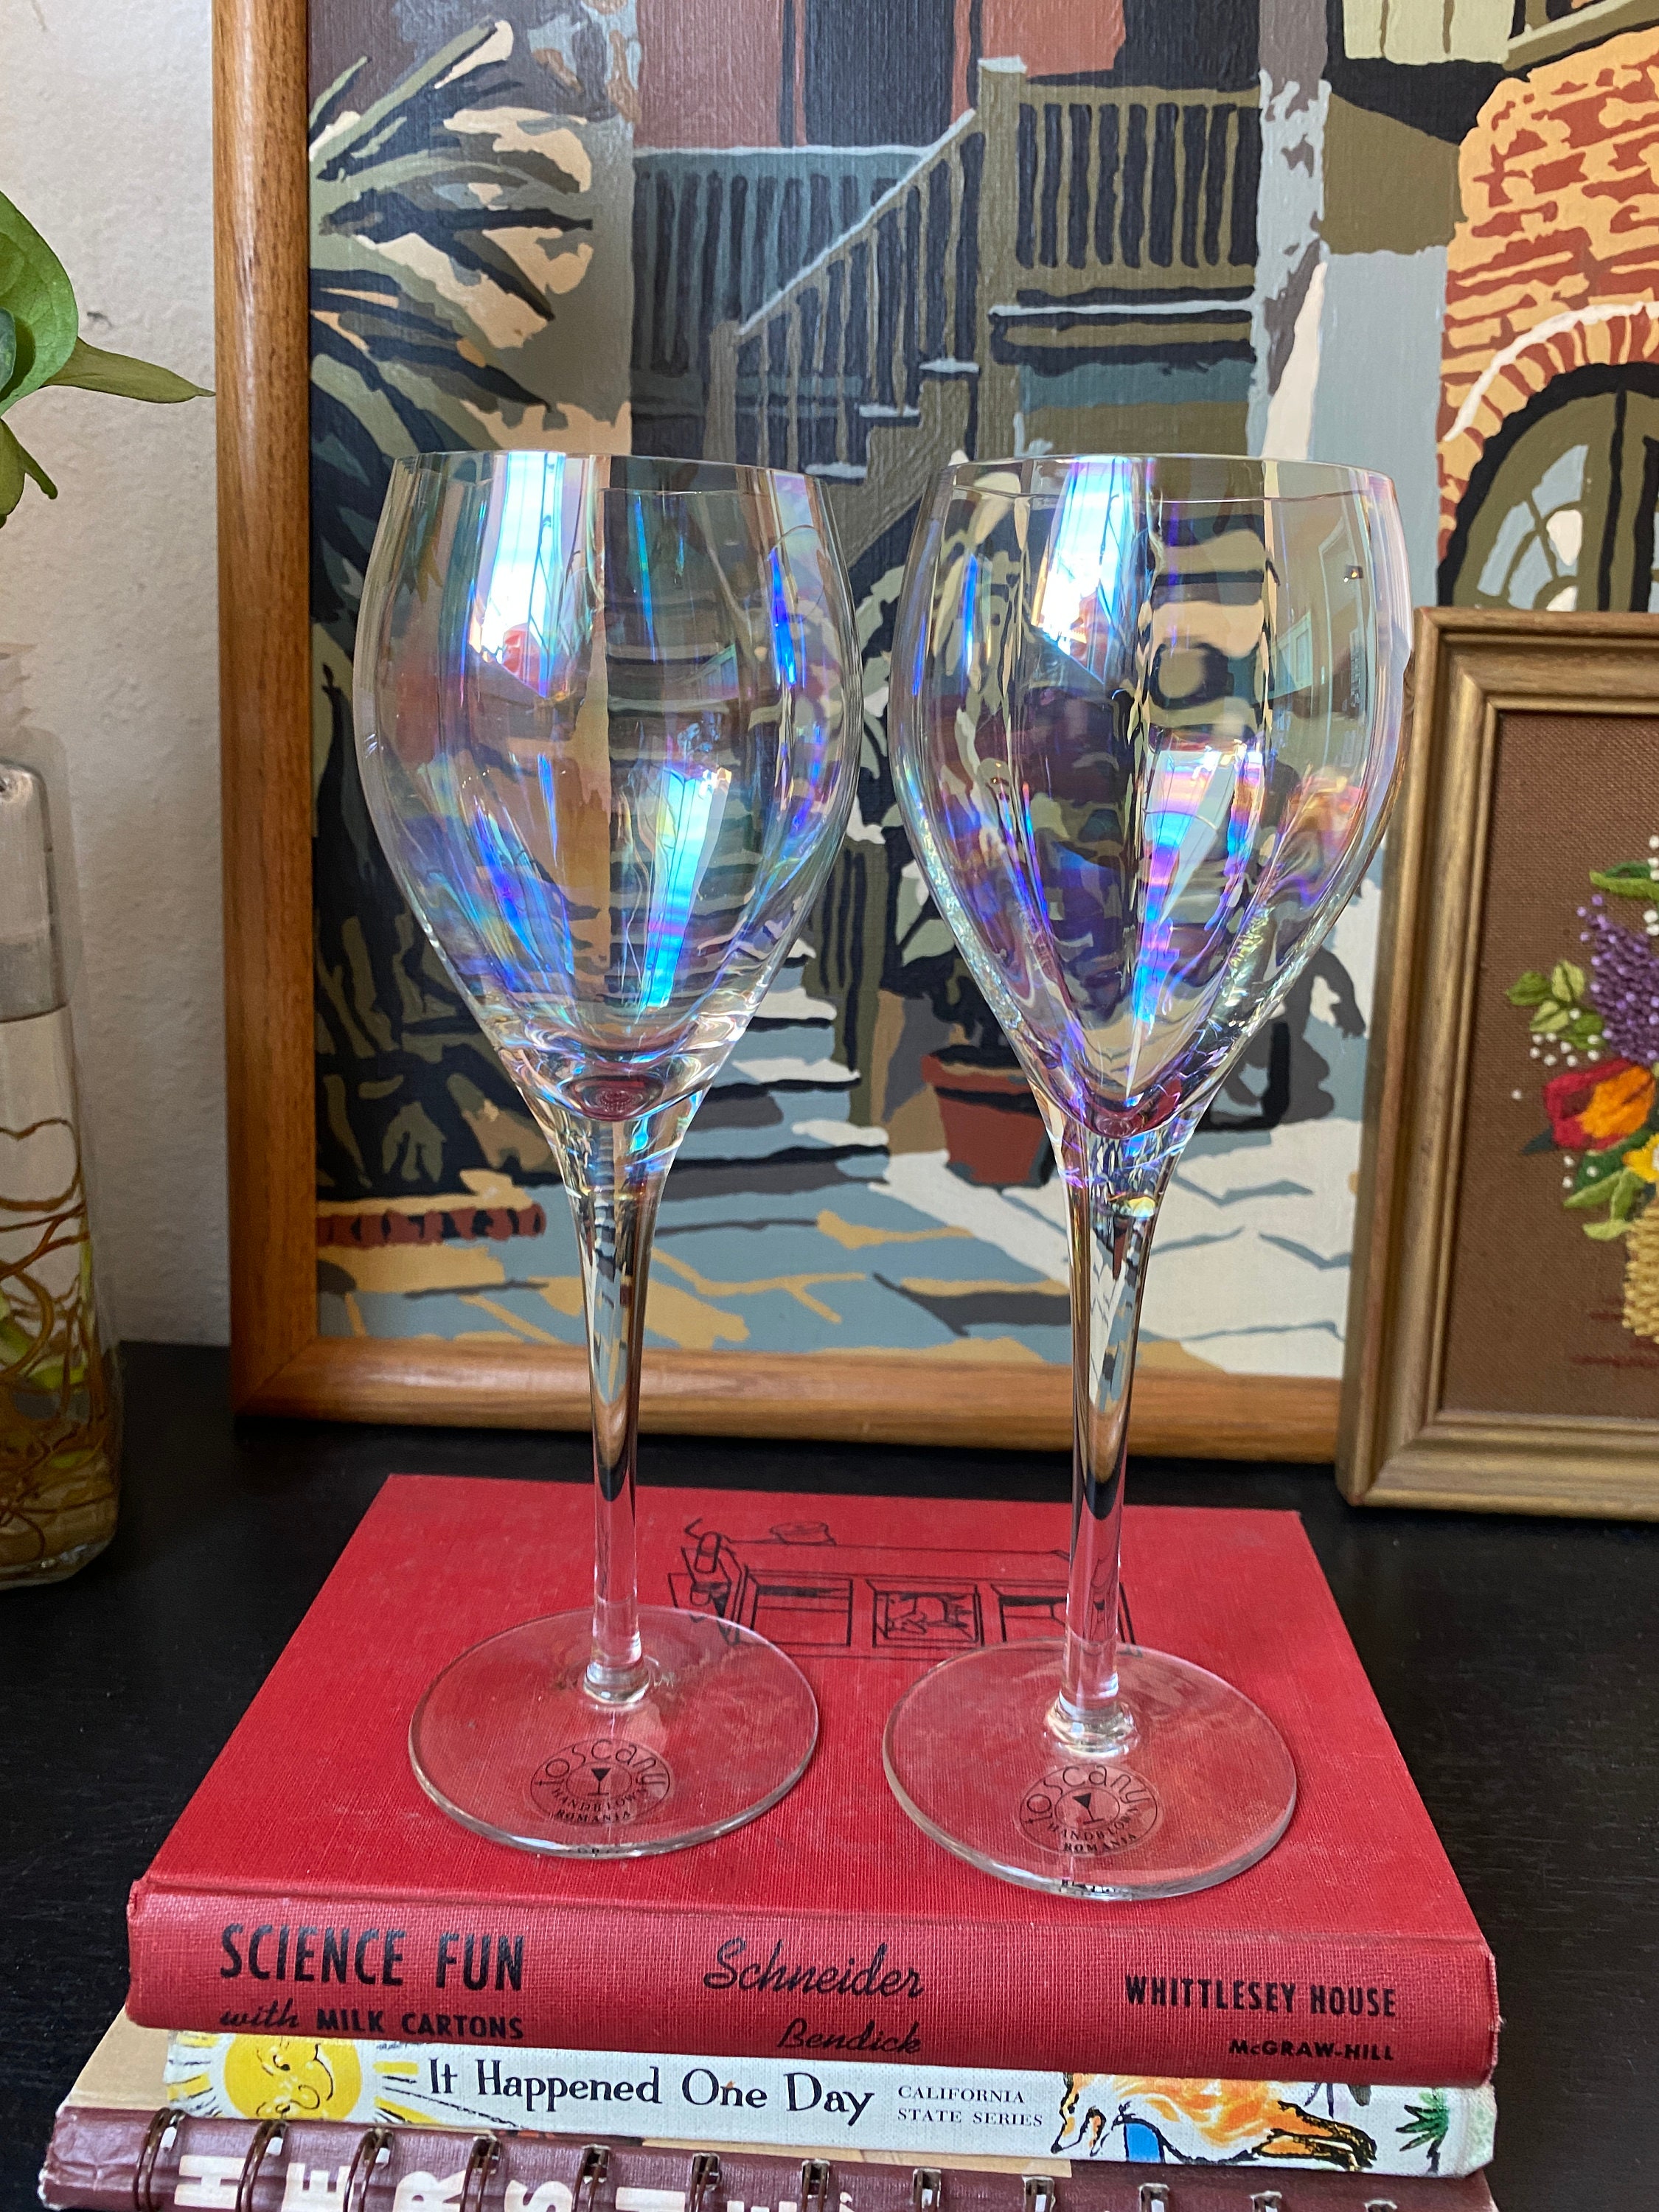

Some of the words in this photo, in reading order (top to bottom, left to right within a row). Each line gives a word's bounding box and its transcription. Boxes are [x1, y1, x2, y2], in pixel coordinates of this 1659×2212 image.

[554, 1808, 632, 1823] ROMANIA
[1063, 1833, 1137, 1852] ROMANIA
[220, 1922, 407, 1987] SCIENCE
[436, 1932, 525, 1992] FUN
[703, 1937, 925, 1998] Schneider
[1124, 1975, 1296, 2014] WHITTLESEY
[1310, 1984, 1397, 2017] HOUSE
[219, 1998, 301, 2029] with
[316, 2008, 383, 2033] MILK
[400, 2011, 524, 2039] CARTONS
[777, 2017, 922, 2054] Bendick
[1228, 2039, 1394, 2061] McGRAW-HILL
[428, 2058, 458, 2095] It
[476, 2059, 662, 2112] Happened
[681, 2068, 768, 2110] One
[783, 2072, 875, 2126] Day
[897, 2085, 1025, 2104] CALIFORNIA
[897, 2107, 962, 2123] STATE
[972, 2111, 1044, 2127] SERIES
